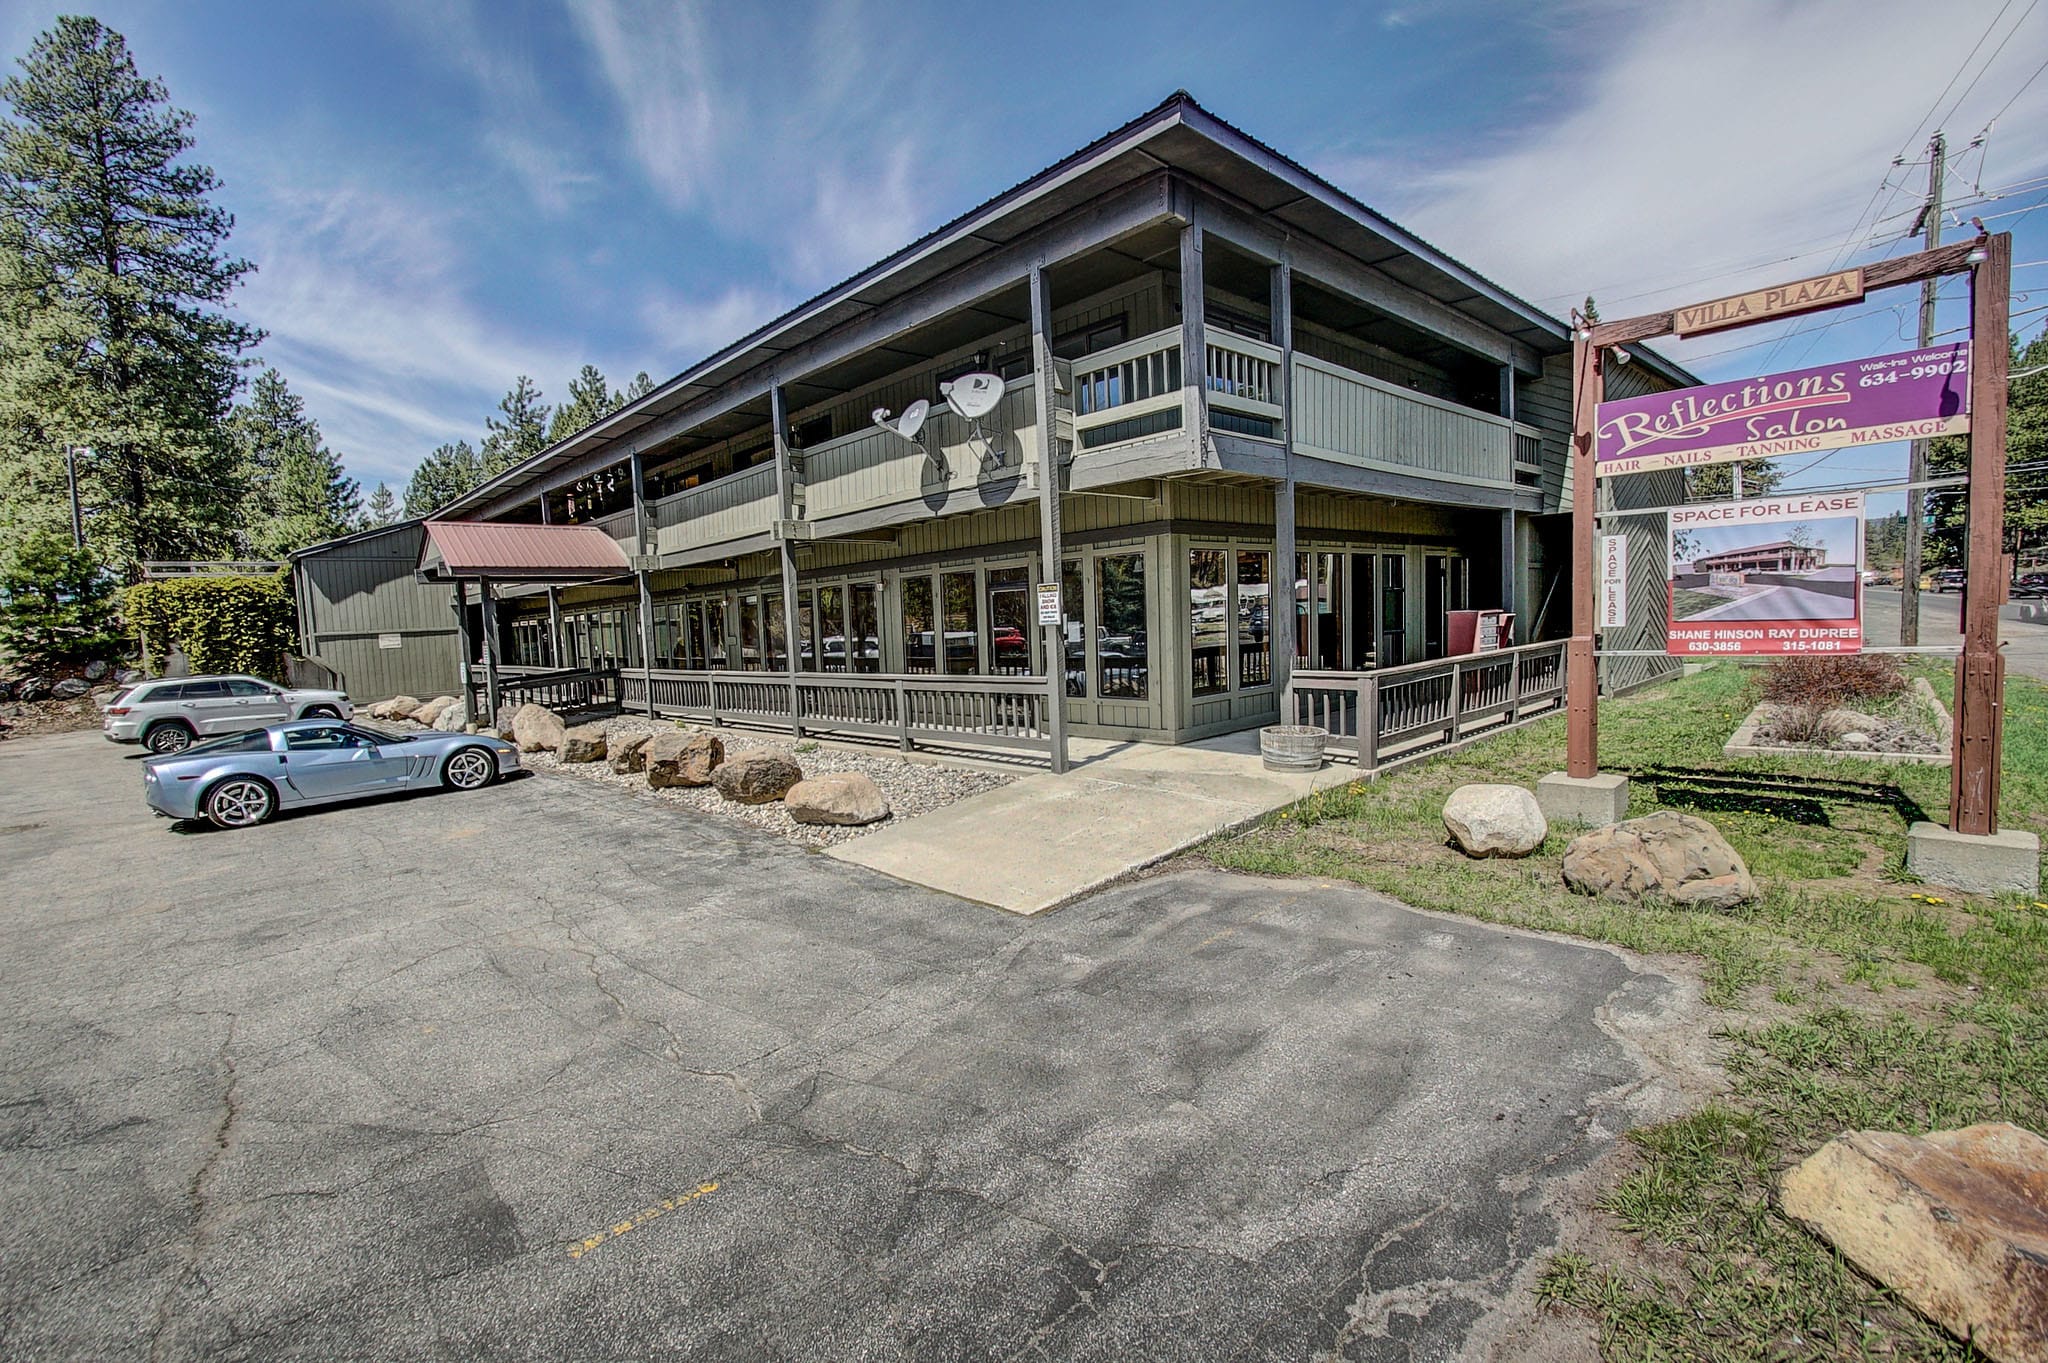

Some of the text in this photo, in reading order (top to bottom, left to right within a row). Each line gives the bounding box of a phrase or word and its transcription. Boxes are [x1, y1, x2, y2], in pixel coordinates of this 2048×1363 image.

[1681, 276, 1853, 328] VILLA PLAZA
[1859, 360, 1968, 387] 634-9902
[1860, 349, 1968, 372] Walk-Ins Welcome
[1598, 372, 1847, 456] Reflections
[1745, 410, 1848, 441] Salon
[1604, 420, 1948, 474] HAIR NAILS TANNING MASSAGE
[1672, 497, 1859, 523] SPACE FOR LEASE
[1607, 538, 1617, 577] SPACE
[1607, 586, 1617, 625] LEASE
[1669, 628, 1859, 640] SHANE HINSON RAY DUPREE
[1688, 641, 1841, 651] 630-3856 315-1081
